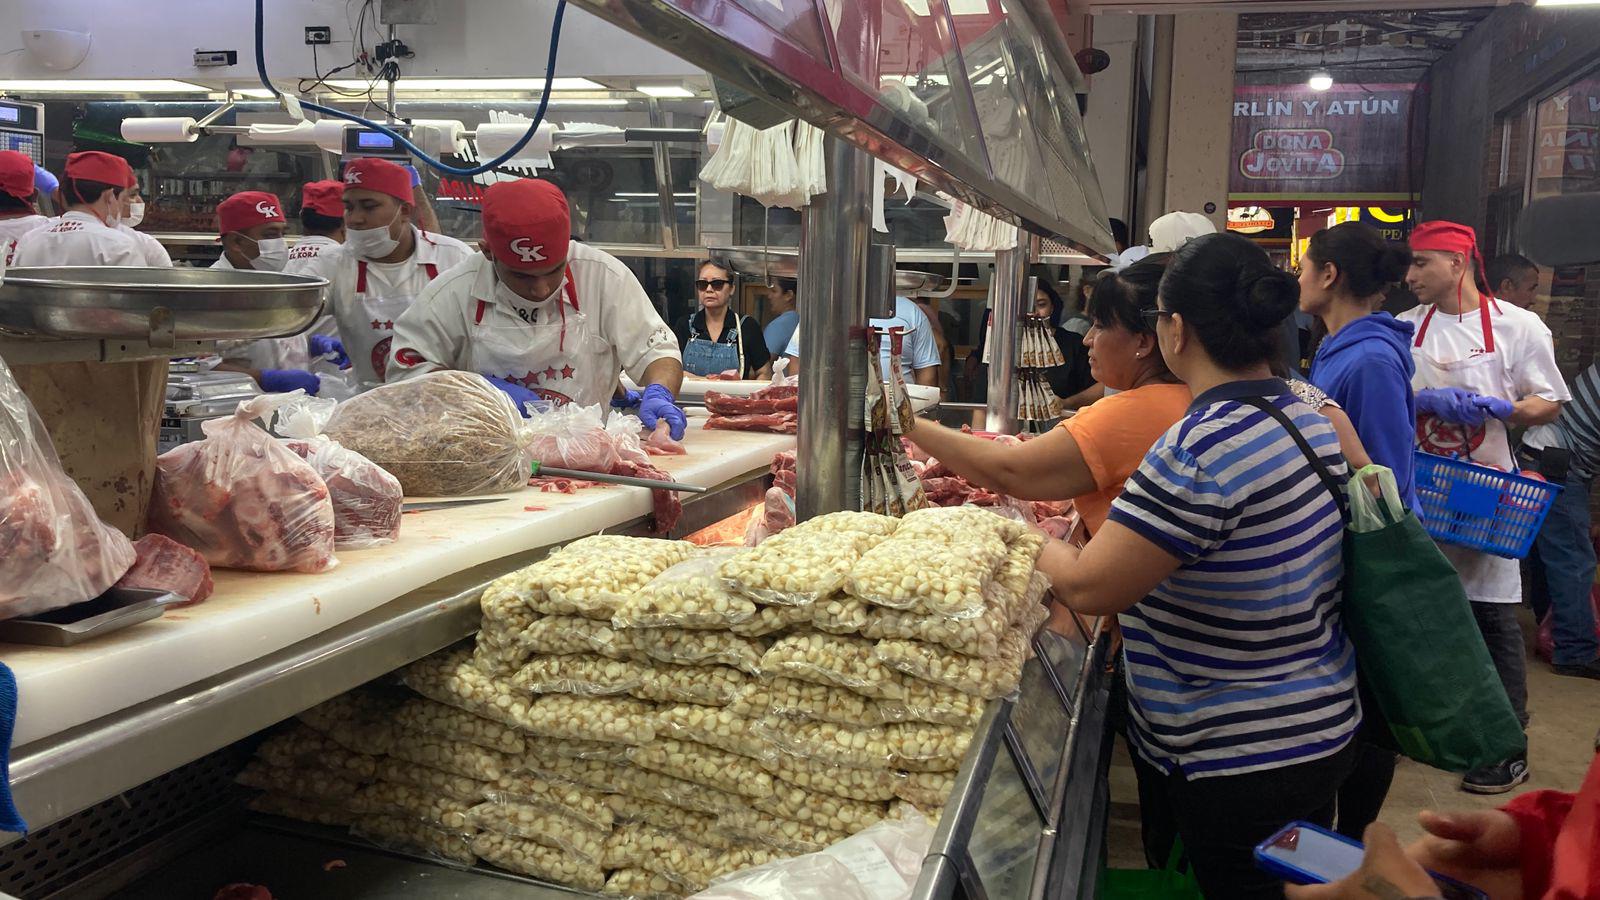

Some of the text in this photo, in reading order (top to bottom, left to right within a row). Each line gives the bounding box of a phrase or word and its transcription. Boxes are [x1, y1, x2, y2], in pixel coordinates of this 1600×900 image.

[1233, 96, 1400, 117] RLÍN Y ATÚN
[1246, 152, 1338, 173] JOVITA
[297, 251, 318, 259] KORA
